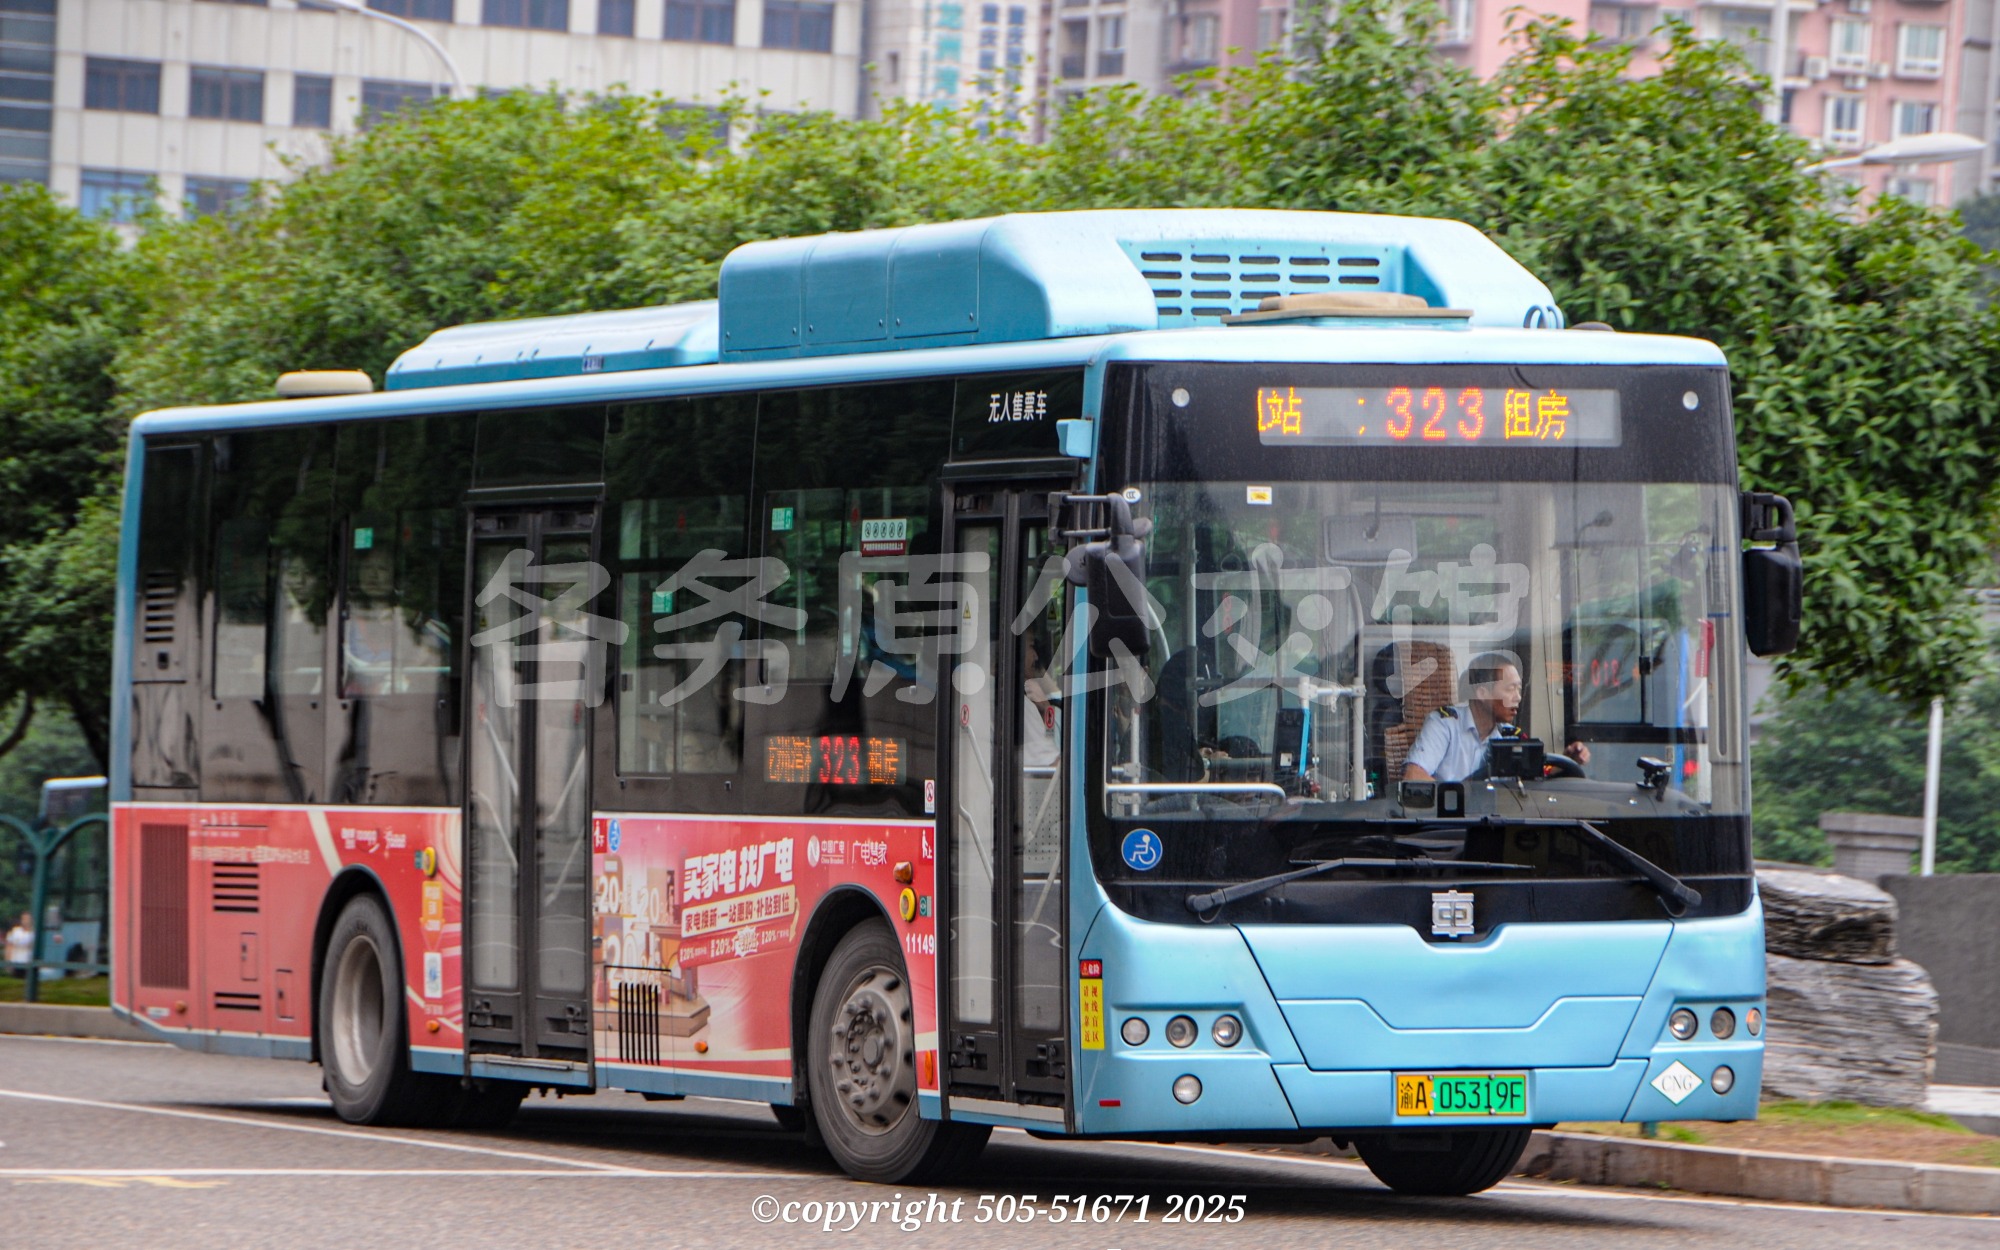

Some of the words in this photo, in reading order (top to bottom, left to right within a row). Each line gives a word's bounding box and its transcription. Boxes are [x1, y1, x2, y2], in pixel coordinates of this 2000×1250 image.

[988, 390, 1047, 422] 无人售票车
[1386, 387, 1484, 439] 323
[819, 736, 860, 783] 323
[821, 840, 845, 854] 中国广电
[852, 840, 887, 865] 广电慧家
[906, 933, 935, 955] 11149
[1440, 1080, 1523, 1110] 05319F
[1661, 1077, 1692, 1091] CNG
